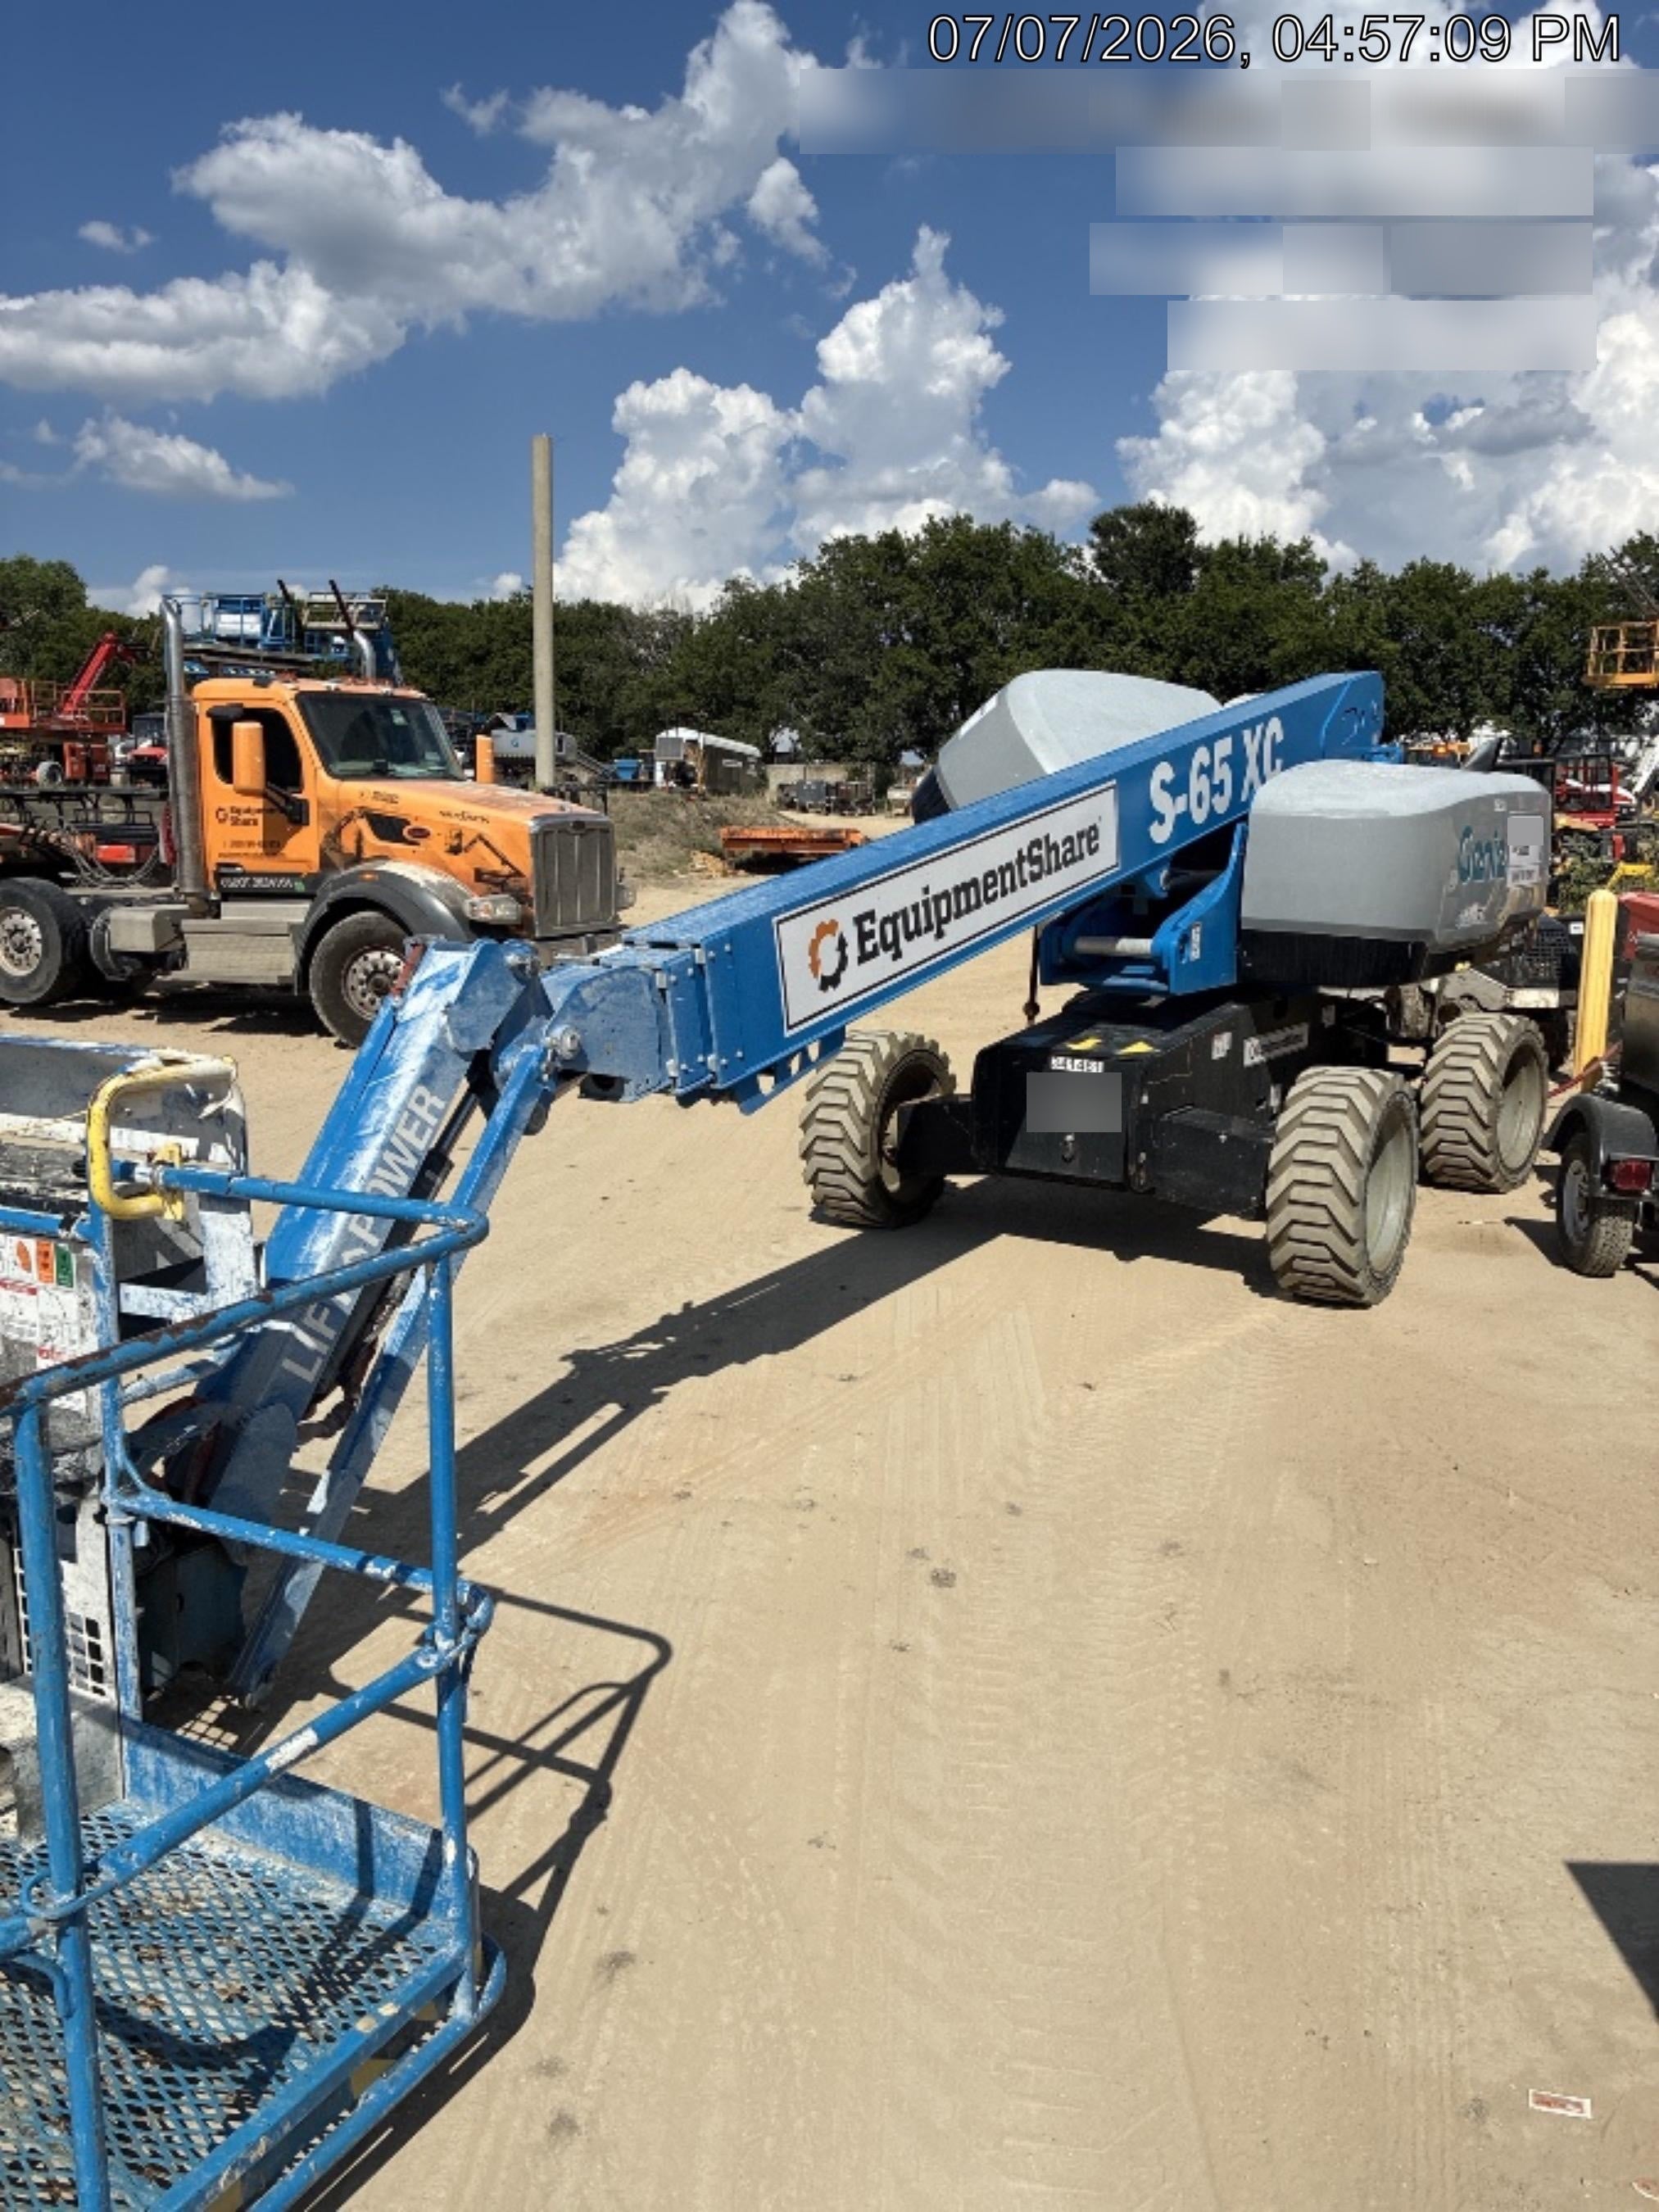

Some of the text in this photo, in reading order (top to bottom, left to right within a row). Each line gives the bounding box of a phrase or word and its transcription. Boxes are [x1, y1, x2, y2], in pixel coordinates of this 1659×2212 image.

[1149, 717, 1284, 843] S-65 XC
[853, 823, 1099, 966] EquipmentShare
